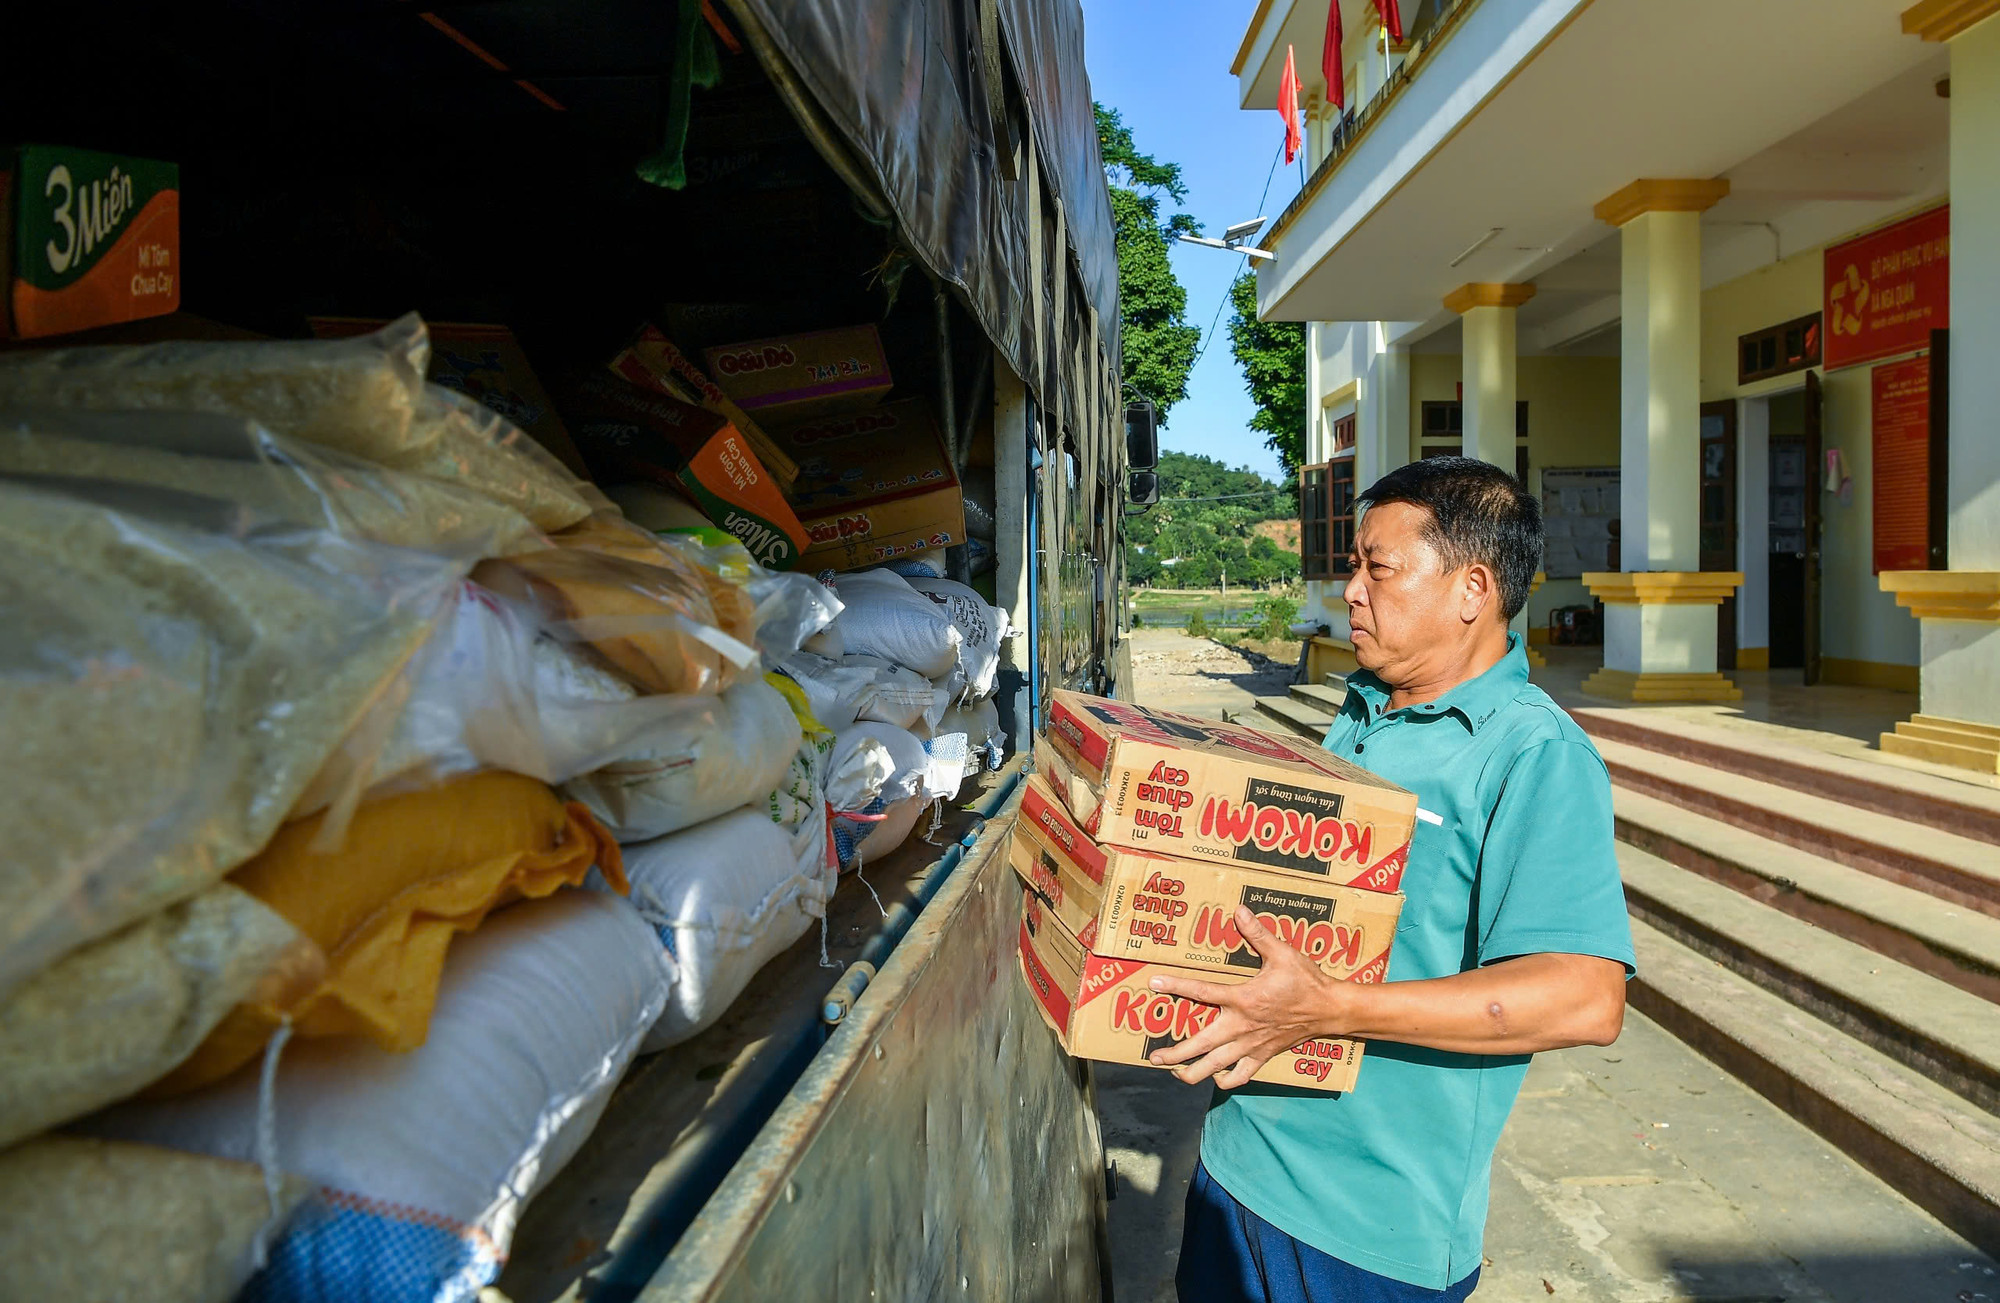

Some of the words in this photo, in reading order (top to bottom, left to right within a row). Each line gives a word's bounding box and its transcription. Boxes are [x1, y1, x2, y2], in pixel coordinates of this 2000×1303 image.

[724, 437, 740, 460] Cay
[740, 456, 758, 485] Chua
[1148, 760, 1189, 786] cay
[1115, 772, 1130, 815] 02KK00313
[1138, 783, 1193, 812] chua
[1294, 792, 1317, 804] ngon
[1319, 799, 1334, 810] dai
[1136, 809, 1183, 837] Tôm
[1199, 796, 1373, 865] KOKOMI
[1143, 872, 1184, 896] cay
[1367, 859, 1400, 888] MỚI
[1110, 885, 1125, 929] 02KK00313
[1133, 894, 1188, 921] chua
[1288, 897, 1310, 908] ngon
[1312, 904, 1327, 915] dai
[1130, 919, 1177, 946] Tôm
[1086, 961, 1125, 993] MỚI
[1113, 990, 1221, 1037] KOK
[1294, 1058, 1333, 1082] cay
